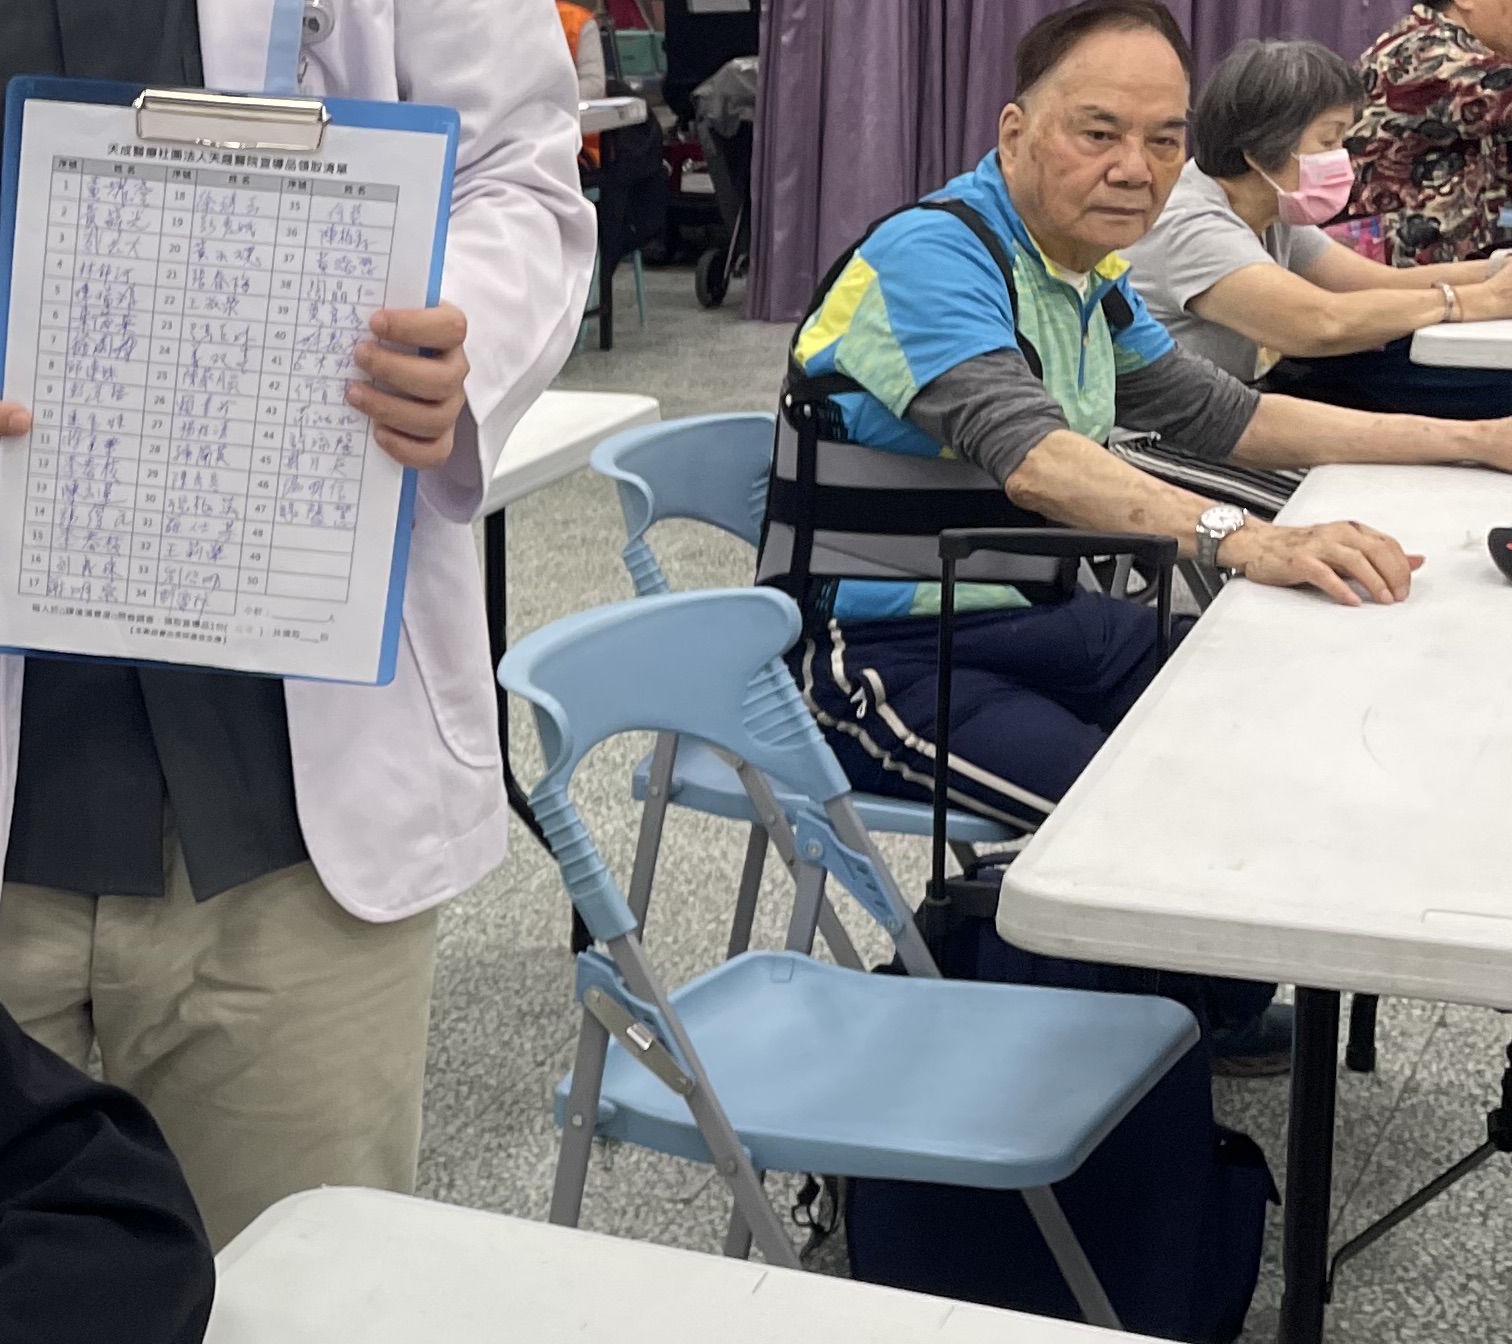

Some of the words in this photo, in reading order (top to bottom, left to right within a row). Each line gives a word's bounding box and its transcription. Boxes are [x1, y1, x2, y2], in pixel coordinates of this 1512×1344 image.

[63, 179, 69, 191] 1
[174, 190, 186, 201] 18
[289, 200, 301, 212] 35
[172, 216, 184, 228] 19
[286, 226, 298, 238] 36
[168, 243, 181, 254] 20
[56, 258, 63, 270] 4
[283, 253, 295, 264] 37
[165, 268, 177, 280] 21
[279, 279, 293, 290] 38
[163, 295, 176, 306] 22
[52, 309, 59, 320] 6
[277, 305, 290, 316] 39
[161, 319, 173, 331] 23
[51, 334, 57, 345] 7
[273, 330, 287, 341] 40
[158, 345, 171, 355] 24
[48, 359, 55, 371] 8
[271, 355, 282, 366] 41
[156, 370, 168, 381] 25
[46, 384, 53, 394] 9
[268, 380, 281, 391] 42
[153, 395, 166, 406] 26
[265, 405, 278, 416] 43
[151, 419, 163, 431] 27
[40, 432, 51, 445] 11
[262, 430, 275, 440] 44
[149, 443, 161, 455] 28
[259, 455, 272, 465] 45
[257, 480, 270, 490] 46
[144, 492, 157, 504] 30
[34, 505, 46, 517] 14
[254, 504, 267, 513] 47
[251, 528, 264, 538] 48
[30, 553, 42, 564] 16
[29, 577, 40, 588] 17
[135, 587, 147, 598] 34
